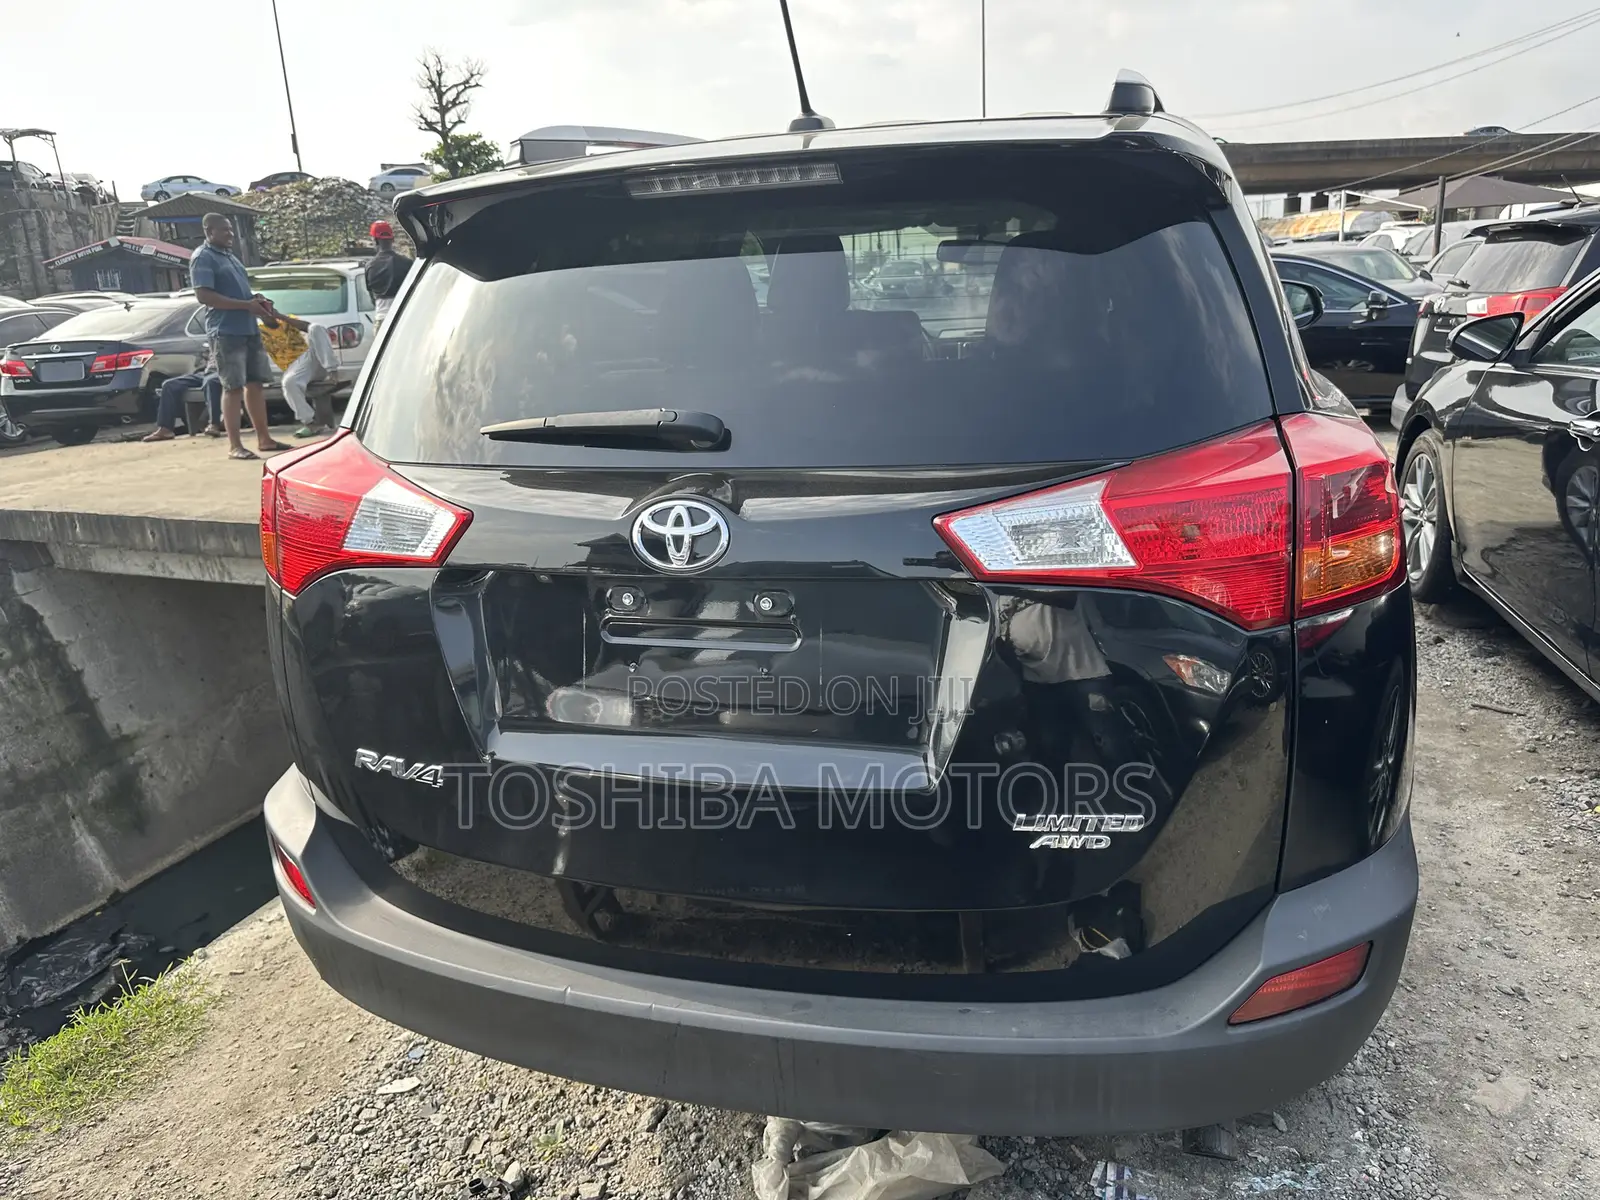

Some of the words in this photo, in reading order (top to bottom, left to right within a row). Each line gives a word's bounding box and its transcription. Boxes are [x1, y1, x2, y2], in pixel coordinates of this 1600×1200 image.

[354, 747, 444, 788] RAV4
[1013, 813, 1146, 832] LIMITED
[1029, 834, 1112, 850] AWD
